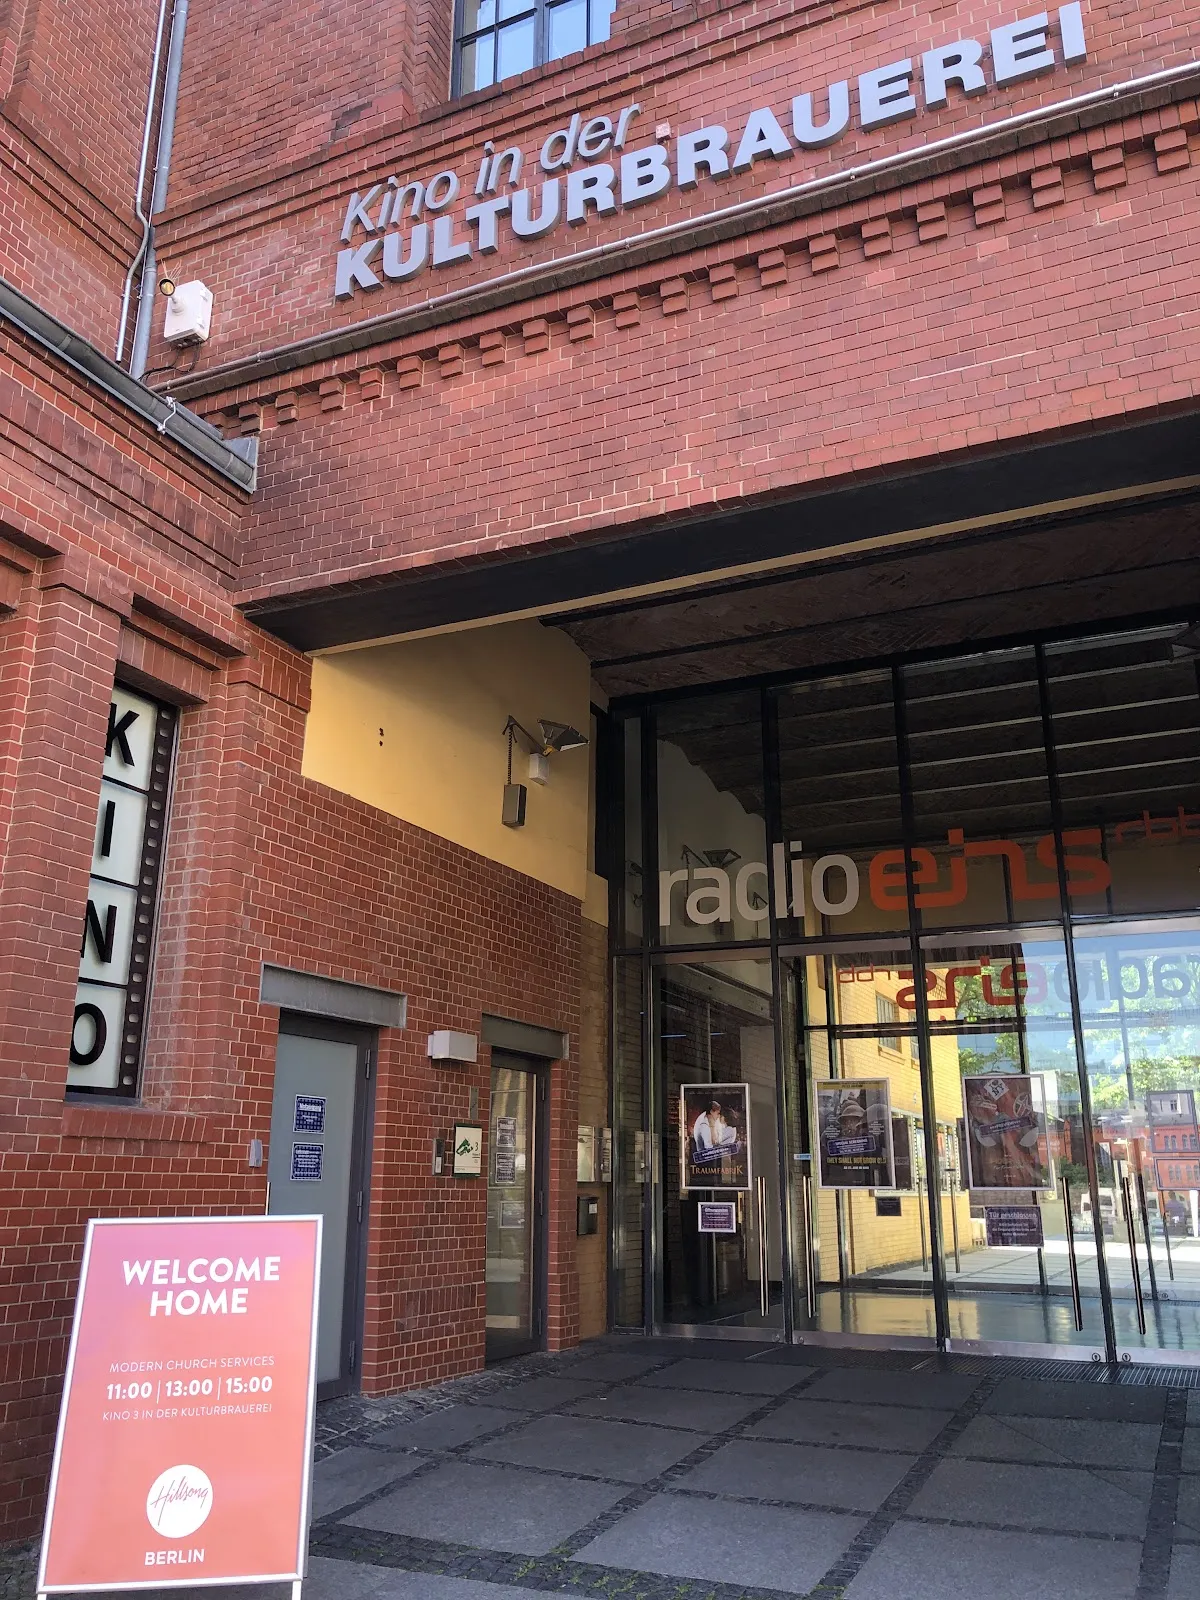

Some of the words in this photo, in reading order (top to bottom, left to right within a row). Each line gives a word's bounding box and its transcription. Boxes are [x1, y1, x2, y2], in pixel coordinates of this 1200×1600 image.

[334, 1, 1087, 300] KULTURBRAUEREI
[339, 172, 458, 244] Kino
[473, 140, 522, 195] in
[540, 102, 641, 172] der
[69, 703, 139, 1067] KINO
[658, 840, 859, 926] radio
[869, 827, 1112, 911] eins
[122, 1256, 281, 1285] WELCOME
[149, 1288, 249, 1316] HOME
[109, 1359, 163, 1373] MODERN
[166, 1357, 218, 1371] CHURCH
[220, 1355, 275, 1369] SERVICES
[106, 1382, 152, 1400] 11:00
[165, 1378, 213, 1397] 13:00
[225, 1375, 273, 1394] 15:00
[102, 1410, 130, 1422] KINO
[133, 1409, 140, 1420] 3
[141, 1409, 153, 1419] IN
[156, 1407, 178, 1419] DER
[181, 1403, 273, 1418] KULTURBRAUEREI
[149, 1475, 209, 1527] Hillsong
[144, 1548, 205, 1566] BERLIN
